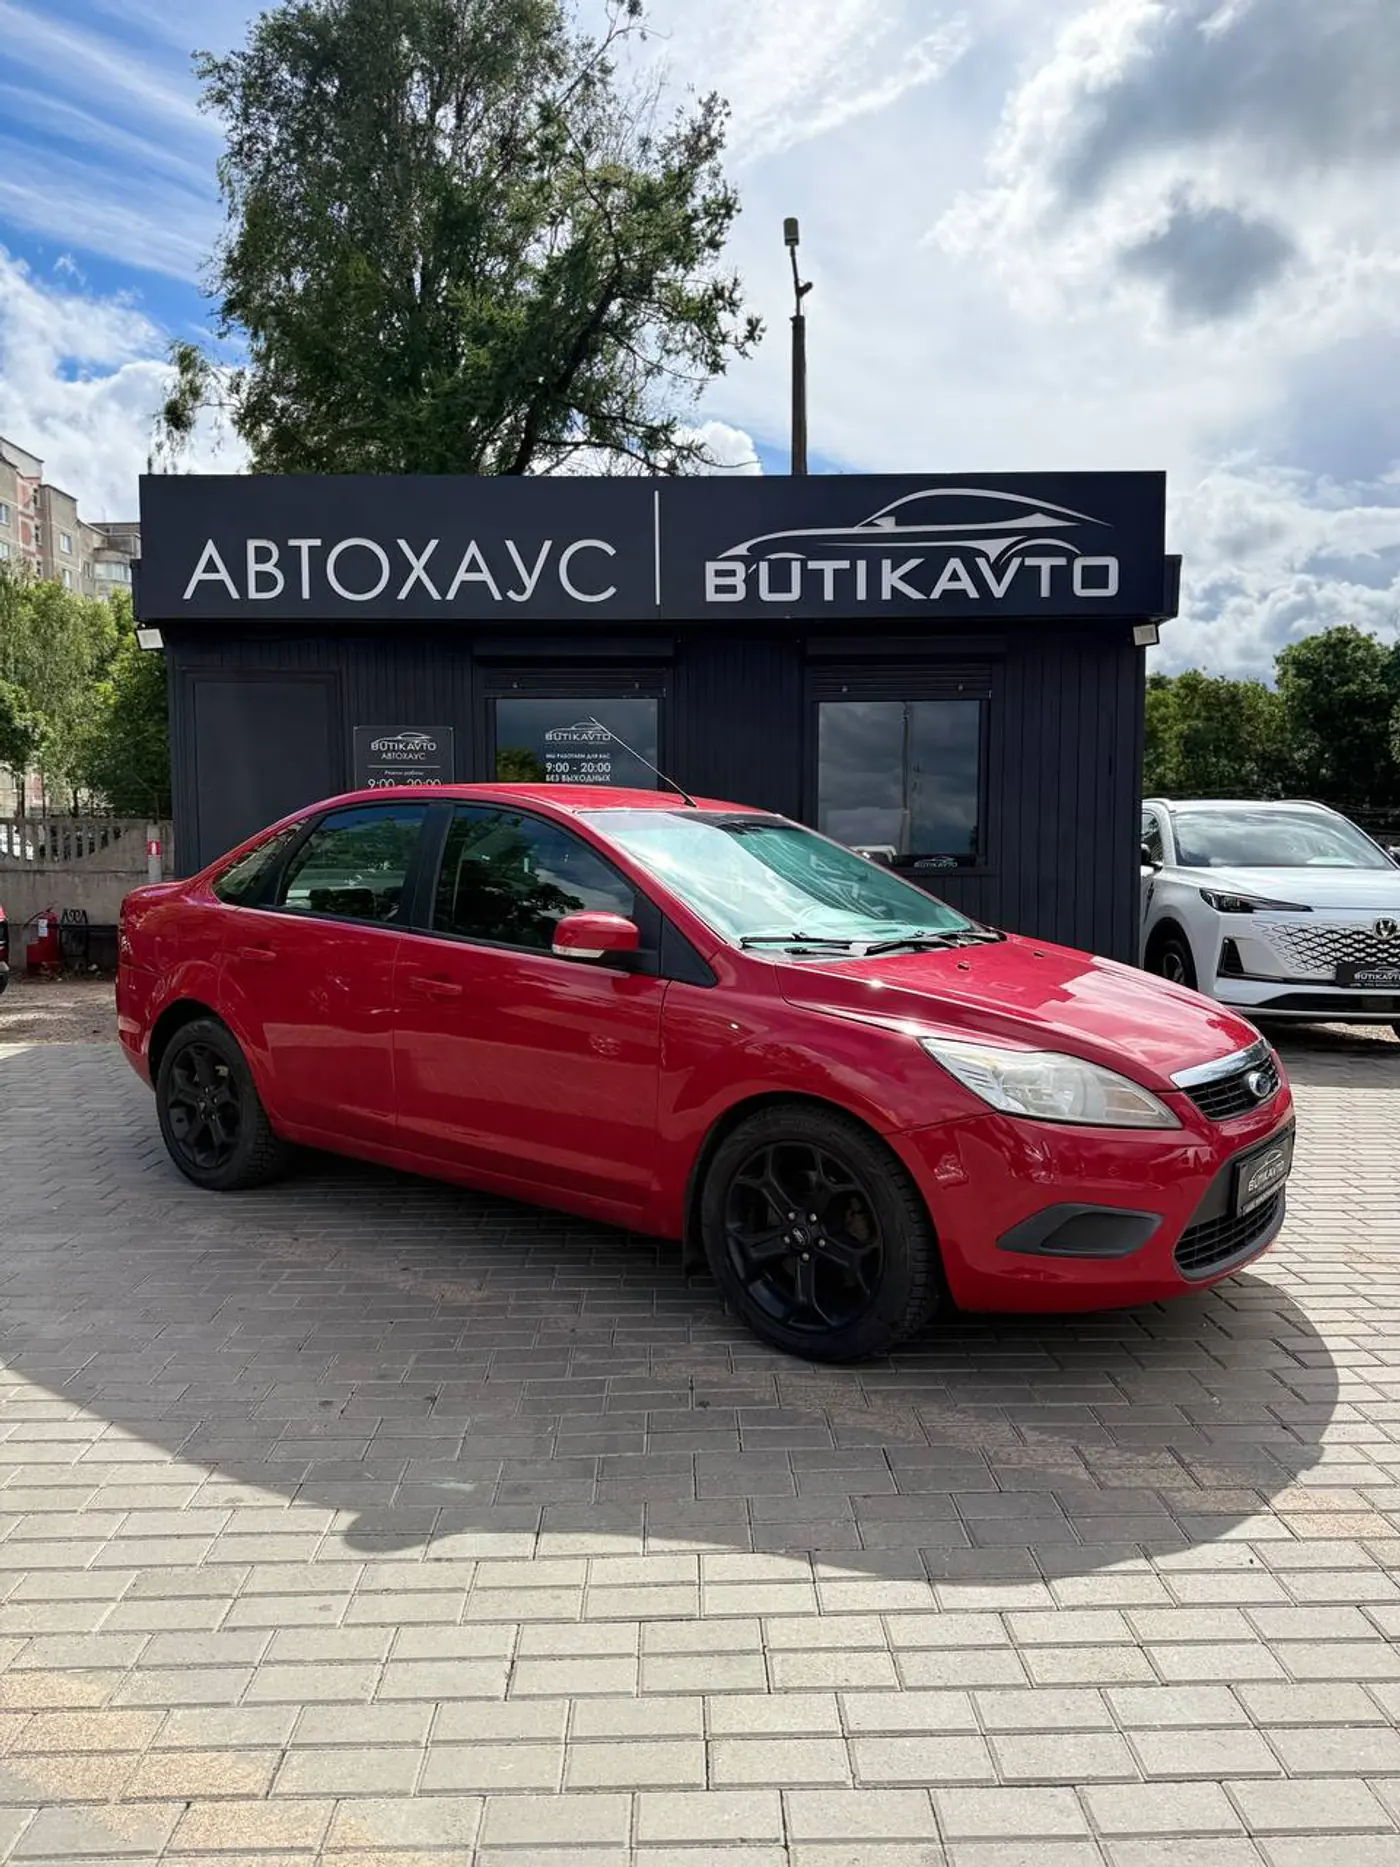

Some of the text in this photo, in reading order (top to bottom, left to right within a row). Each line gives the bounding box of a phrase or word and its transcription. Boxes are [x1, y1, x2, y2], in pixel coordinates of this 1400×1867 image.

[183, 537, 617, 602] АВТОХАУС
[704, 555, 1120, 603] BUTIKAVTO
[545, 732, 611, 741] BUTIKAVTO
[370, 742, 437, 751] BUTIKAVTO
[381, 752, 426, 760] АВТОХАУС
[545, 762, 569, 773] 9:00
[580, 762, 611, 773] 20:00
